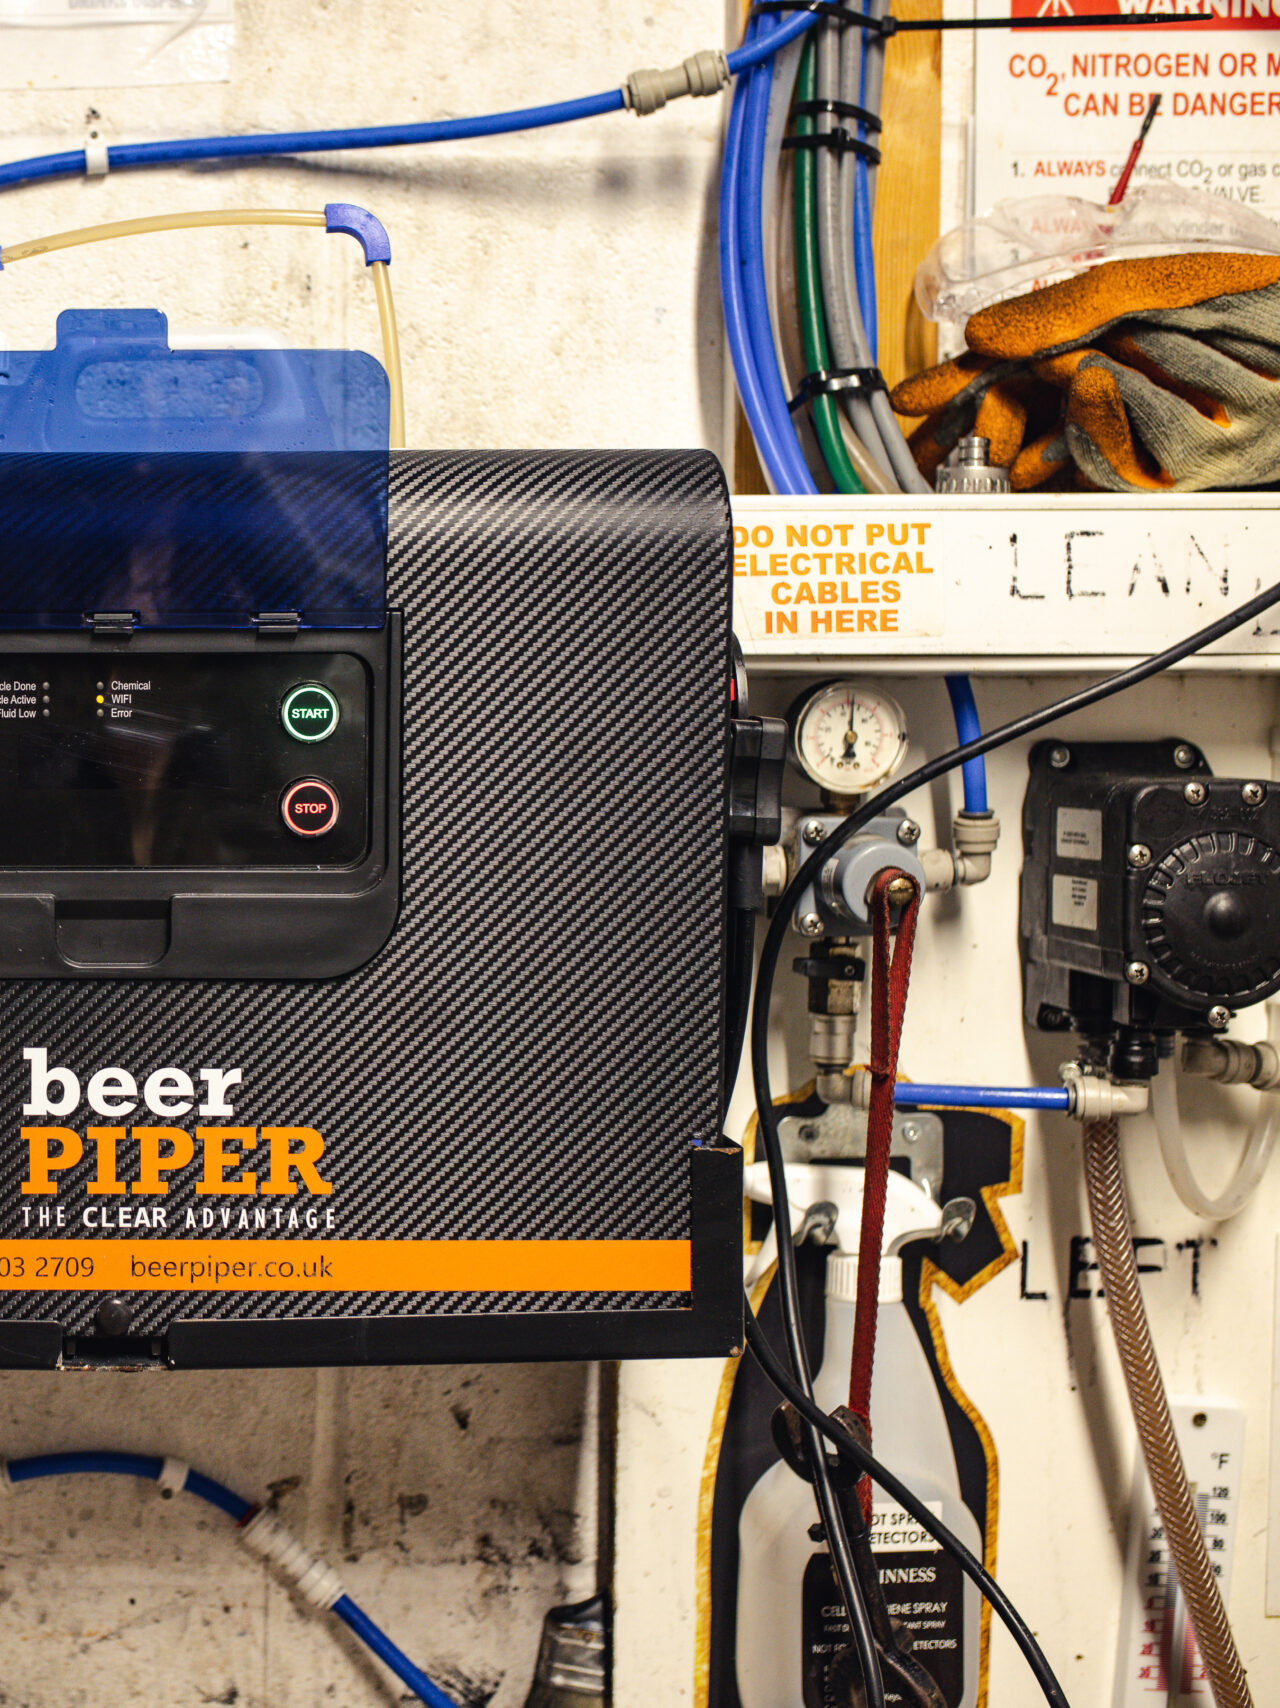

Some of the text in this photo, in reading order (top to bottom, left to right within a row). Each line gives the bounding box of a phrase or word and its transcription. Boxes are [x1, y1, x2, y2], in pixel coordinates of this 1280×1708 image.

[1072, 53, 1209, 77] NITROGEN
[1219, 53, 1257, 77] OR
[1064, 93, 1119, 117] CAN
[1034, 160, 1106, 177] ALWAYS
[1110, 161, 1171, 177] cnect
[1218, 163, 1233, 177] or
[1238, 163, 1266, 181] gas
[733, 523, 931, 548] DO NOT PUT
[732, 552, 934, 576] ELECTRICAL
[771, 580, 901, 605] CABLES
[765, 609, 899, 634] IN HERE
[13, 681, 37, 691] Done
[111, 681, 151, 690] Chemical
[10, 695, 37, 704] Active
[111, 694, 132, 704] WIFI
[19, 708, 37, 718] Low
[111, 708, 132, 718] Error
[291, 708, 329, 719] START
[294, 803, 327, 814] STOP
[23, 1047, 242, 1117] beer
[20, 1127, 333, 1195] PIPER
[22, 1206, 336, 1230] THE CLEAR ADVANTAGE
[35, 1256, 95, 1278] 2709
[131, 1255, 333, 1283] beerpiper.co.uk
[871, 1512, 928, 1525] OT SPR
[870, 1530, 935, 1545] ETECTORS
[879, 1566, 936, 1584] INNESS
[821, 1605, 846, 1617] CELL
[912, 1601, 948, 1615] SPRAY
[913, 1639, 958, 1650] ETECTORS
